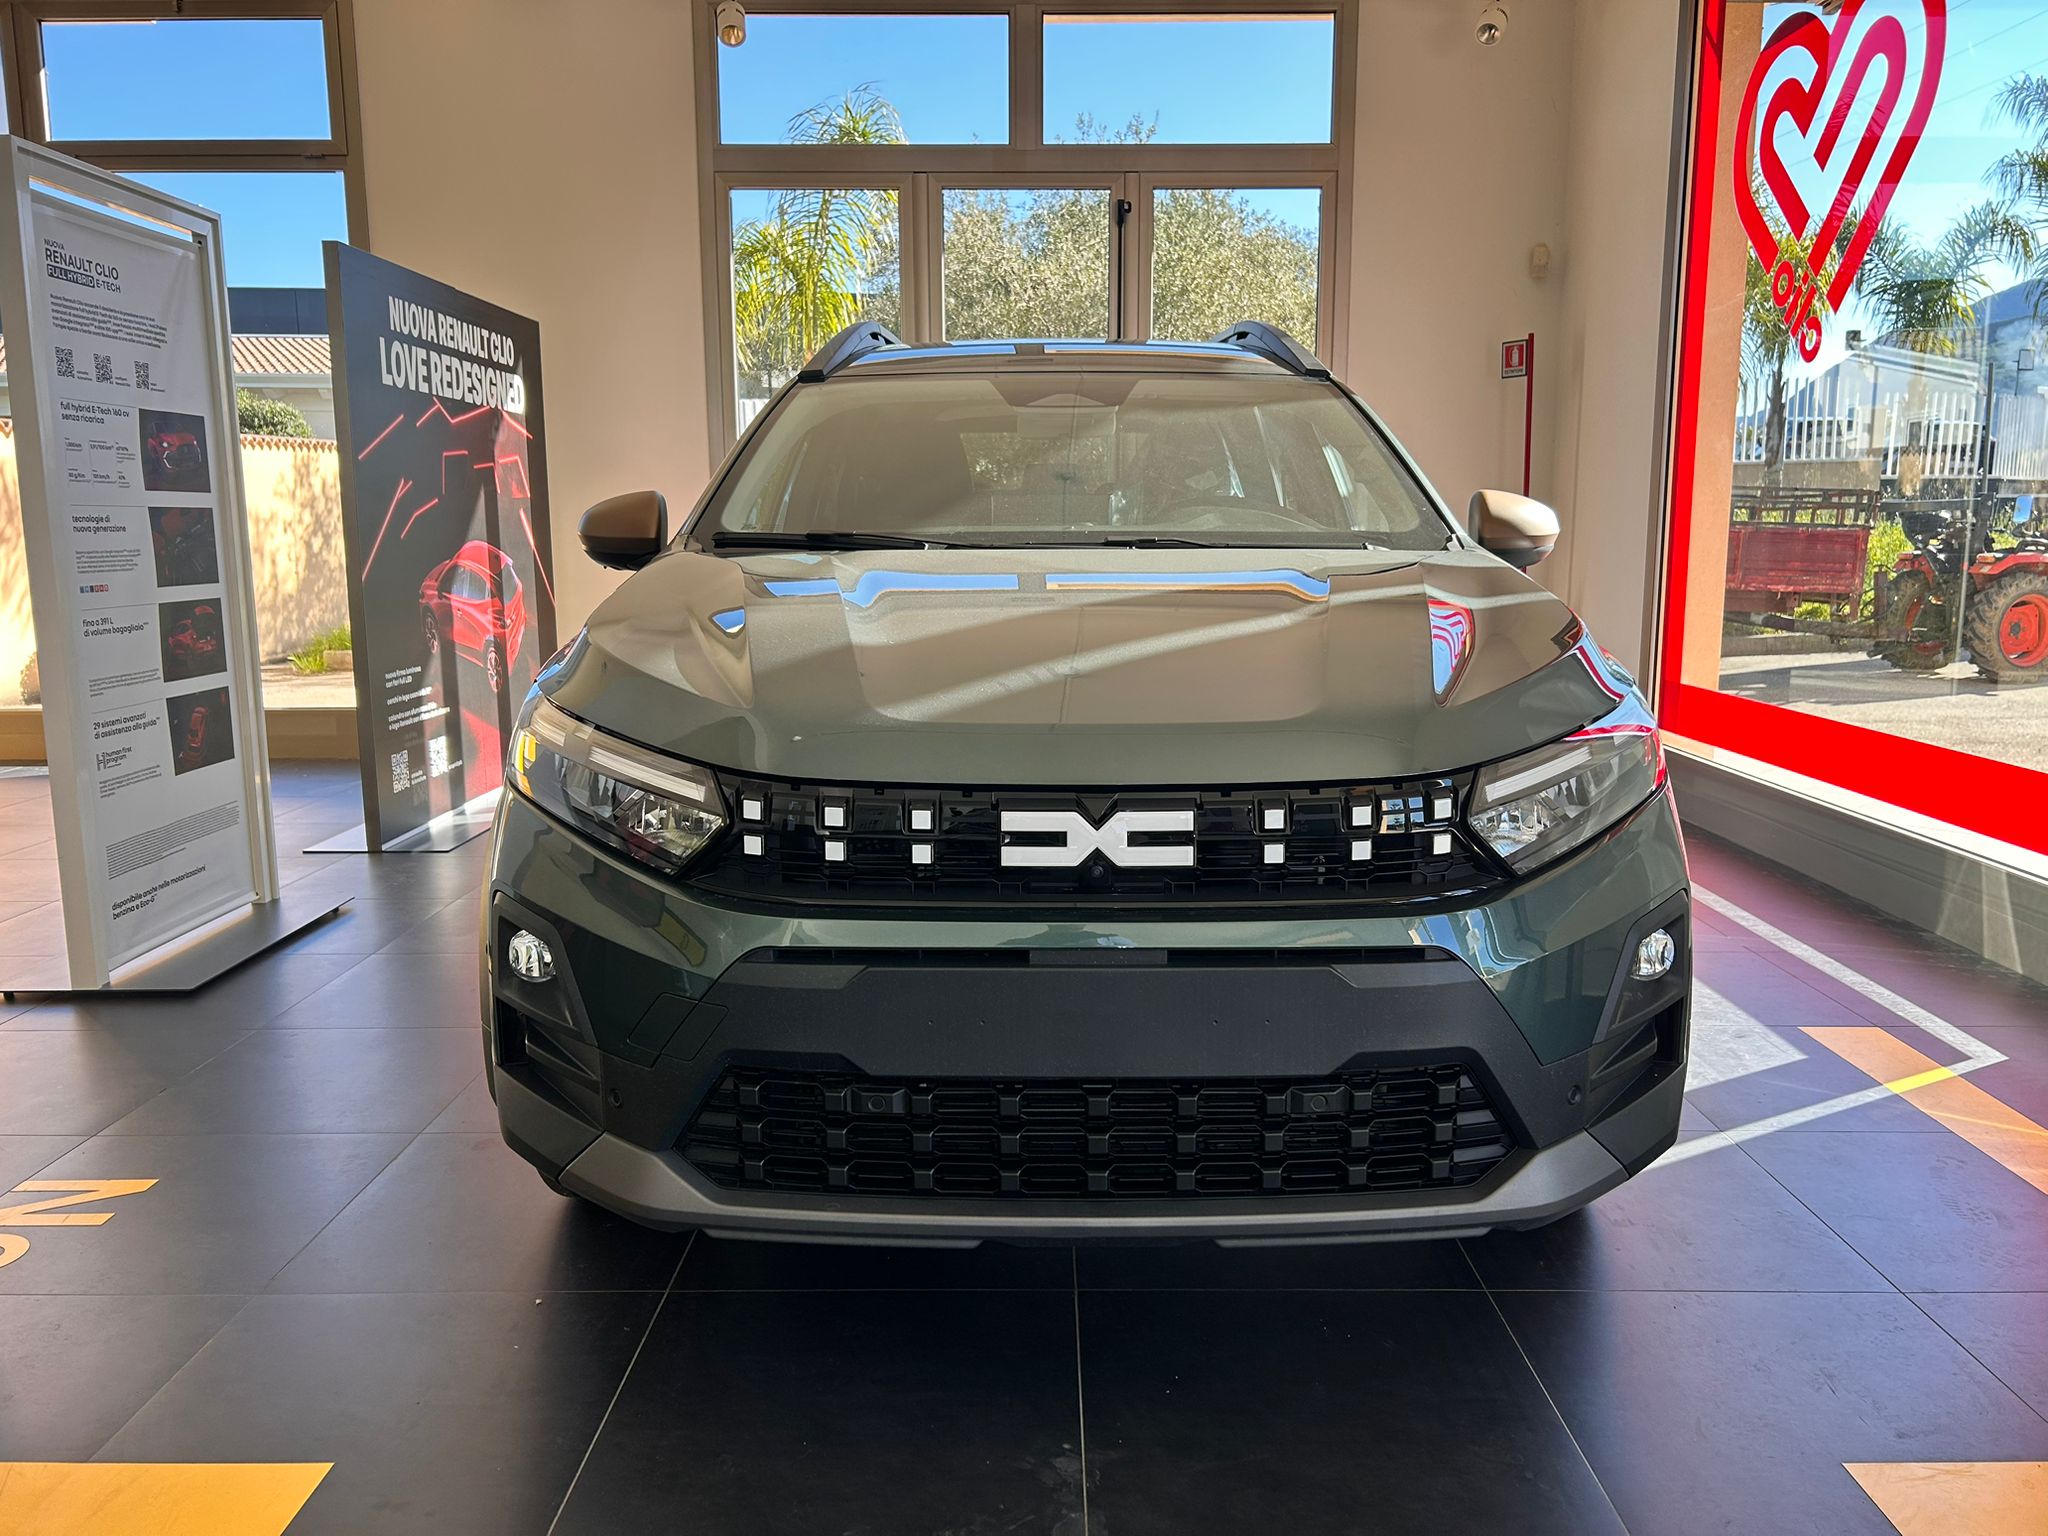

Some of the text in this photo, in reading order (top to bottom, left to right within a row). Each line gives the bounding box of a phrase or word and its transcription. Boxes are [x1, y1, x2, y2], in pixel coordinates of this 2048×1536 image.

[44, 238, 65, 250] NUOVA
[45, 247, 119, 280] RENAULT CLIO
[48, 266, 121, 293] FULL HYBRID E-TECH
[389, 295, 515, 367] NUOVA RENAULT CLIO
[379, 337, 525, 415] LOVE REDESIGNED
[60, 401, 70, 410] full
[71, 403, 91, 413] hybrid
[92, 406, 112, 415] E-Tech
[61, 413, 105, 424] senza ricarica
[72, 514, 110, 525] tecnologie di
[92, 525, 127, 534] generazione
[84, 629, 90, 637] di
[90, 628, 111, 637] volume
[93, 711, 146, 730] 29 sistemi avanzati
[94, 730, 100, 739] di
[101, 726, 131, 738] assistenza
[132, 722, 142, 730] alla
[106, 749, 121, 757] human
[106, 754, 126, 764] program
[112, 864, 206, 911] disponibile anche nelle motorizzazioni
[112, 905, 135, 920] benzina
